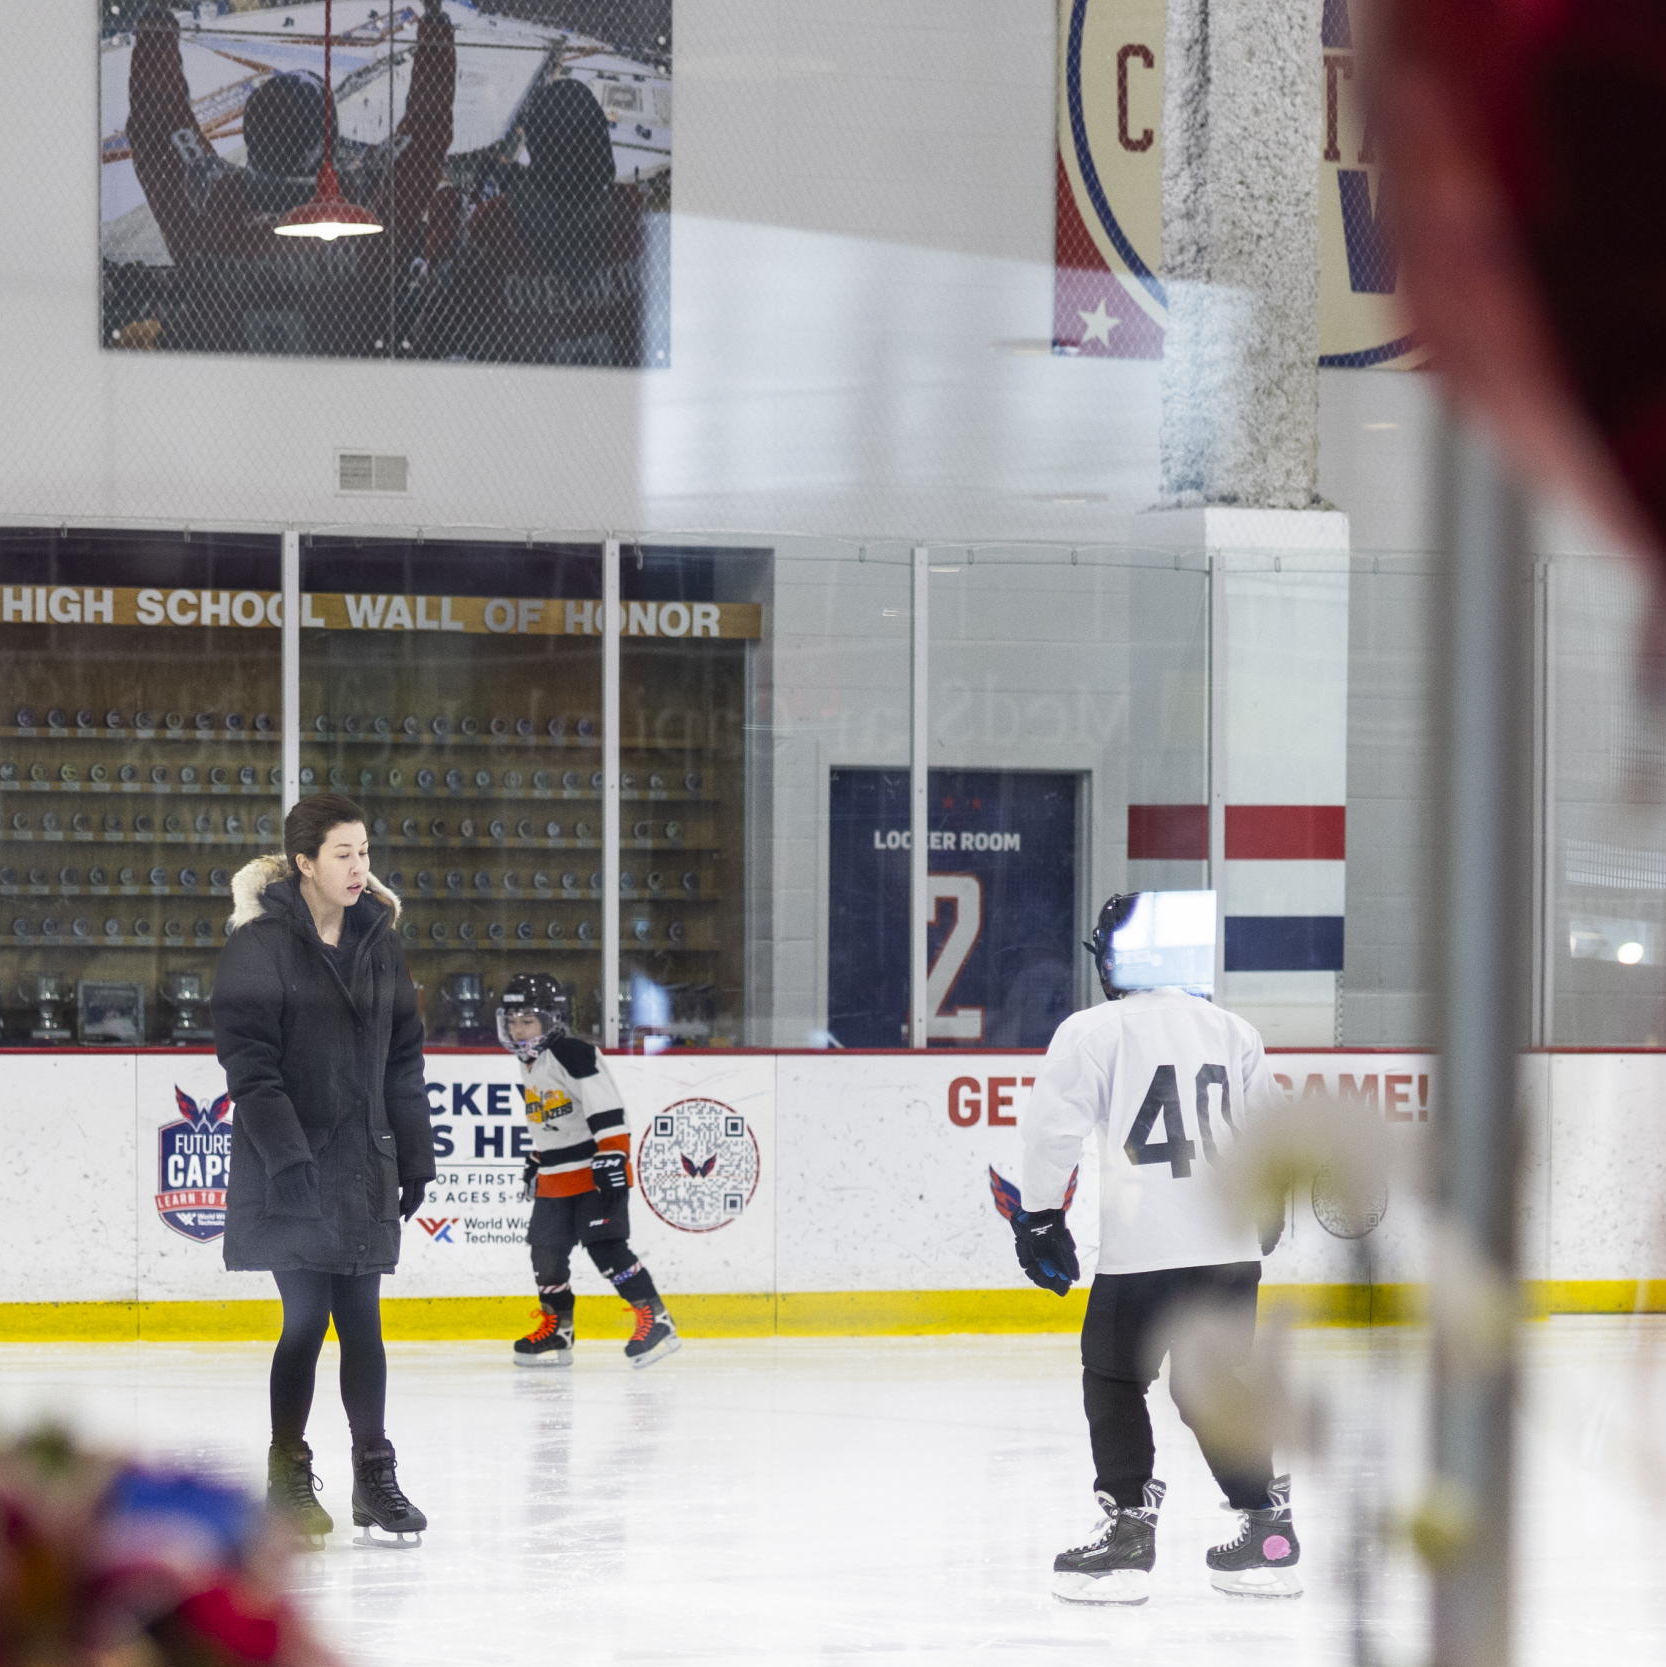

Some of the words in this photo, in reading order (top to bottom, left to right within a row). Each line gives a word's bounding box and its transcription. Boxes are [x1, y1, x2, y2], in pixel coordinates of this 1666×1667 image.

[2, 586, 114, 623] HIGH
[136, 588, 325, 628] SCHOOL
[345, 594, 464, 631] WALL
[484, 599, 544, 633] OF
[874, 830, 956, 850] LOCER
[961, 832, 1021, 851] ROOM
[901, 870, 985, 1042] 2
[1123, 1063, 1247, 1179] 40
[176, 1134, 231, 1154] FUTURE
[202, 1192, 215, 1204] TO
[446, 1191, 490, 1203] AGES
[464, 1218, 502, 1230] World
